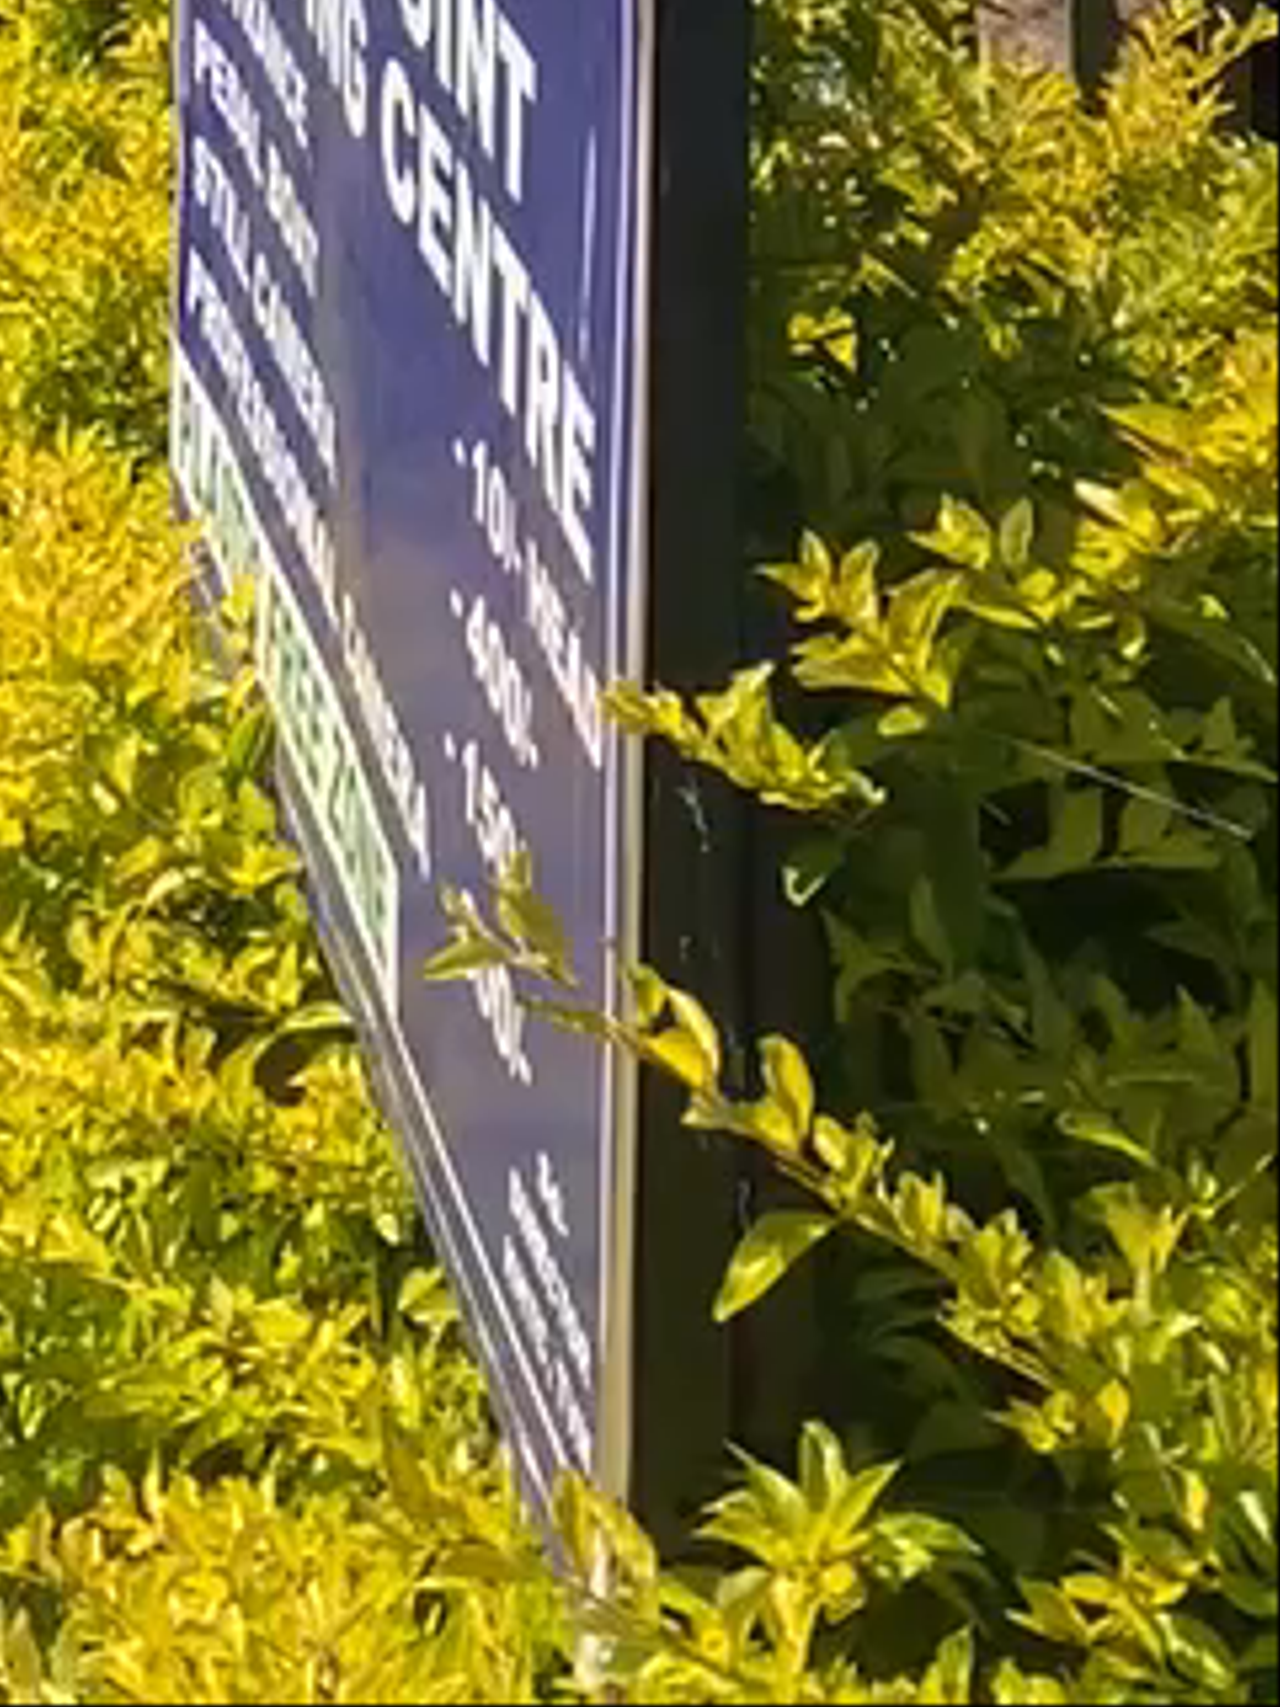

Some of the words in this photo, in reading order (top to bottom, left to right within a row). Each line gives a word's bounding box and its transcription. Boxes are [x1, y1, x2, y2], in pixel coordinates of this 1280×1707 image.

[193, 19, 261, 188] PEDAL
[192, 136, 249, 291] STILL
[253, 253, 336, 484] CAMERA
[380, 58, 594, 583] CENTRE
